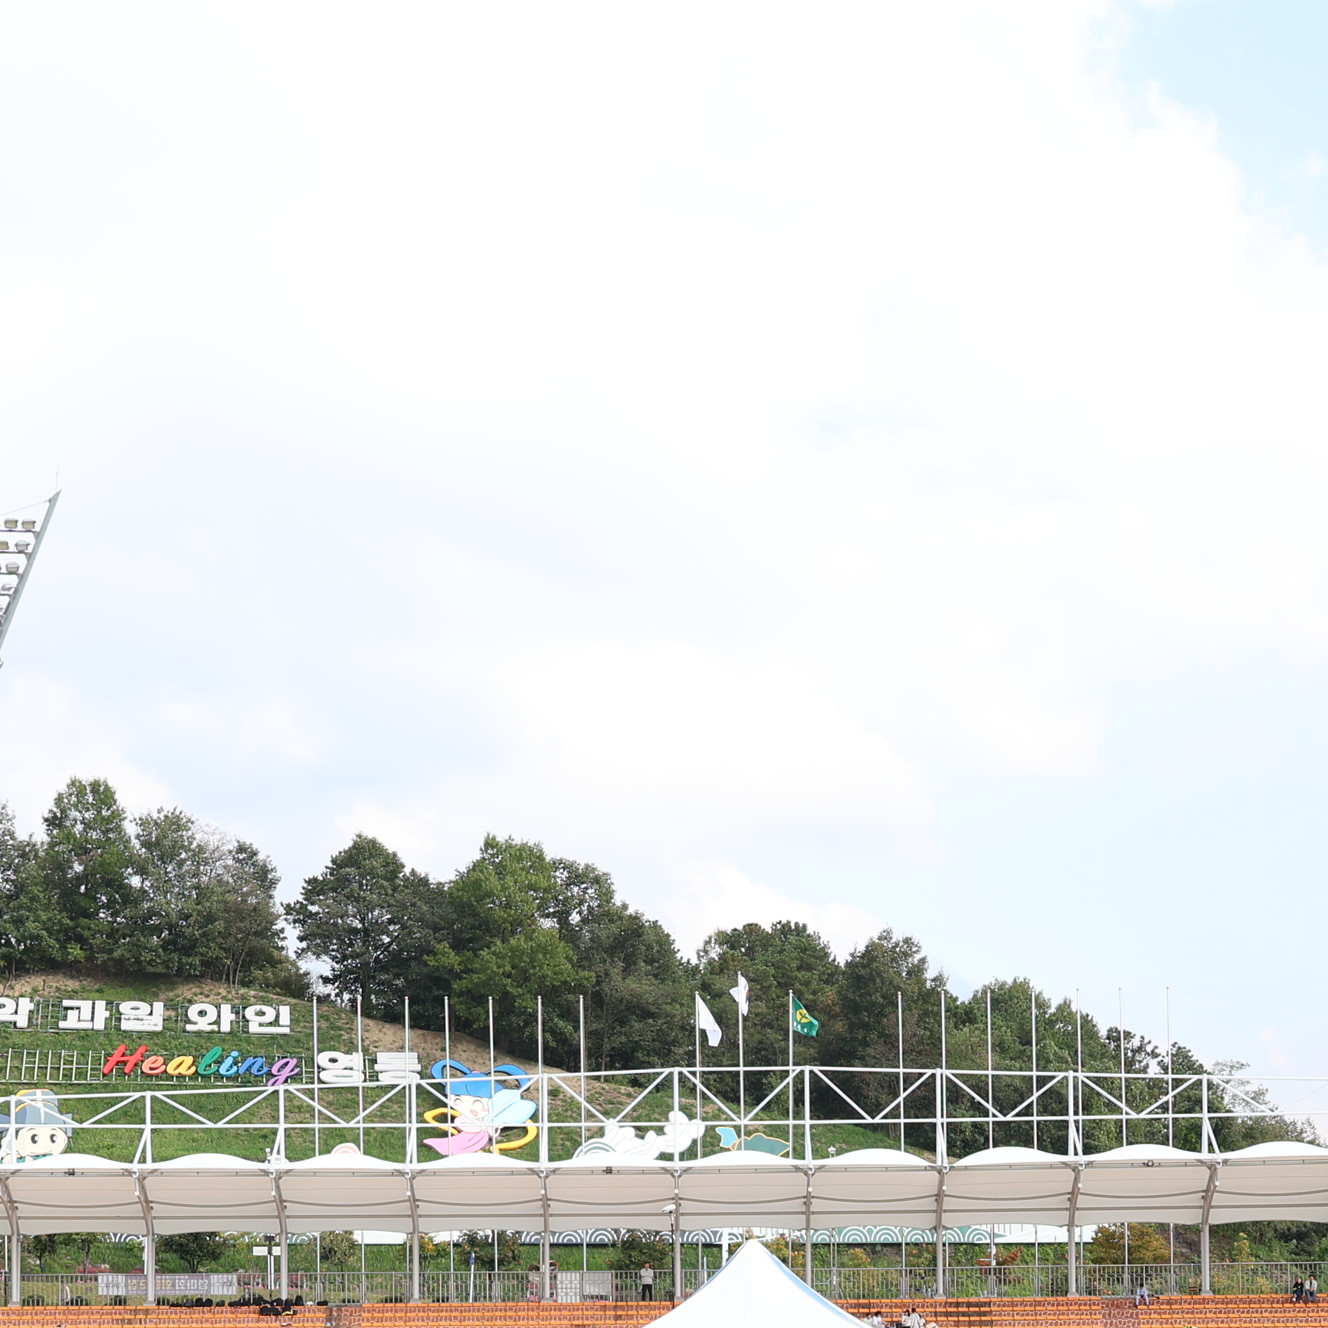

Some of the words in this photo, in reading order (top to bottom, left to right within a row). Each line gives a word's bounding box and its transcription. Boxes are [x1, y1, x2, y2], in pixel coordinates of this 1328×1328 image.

[58, 1000, 164, 1032] 과일
[187, 1003, 290, 1035] 와인
[102, 1043, 301, 1086] Healing
[317, 1051, 421, 1083] 영동
